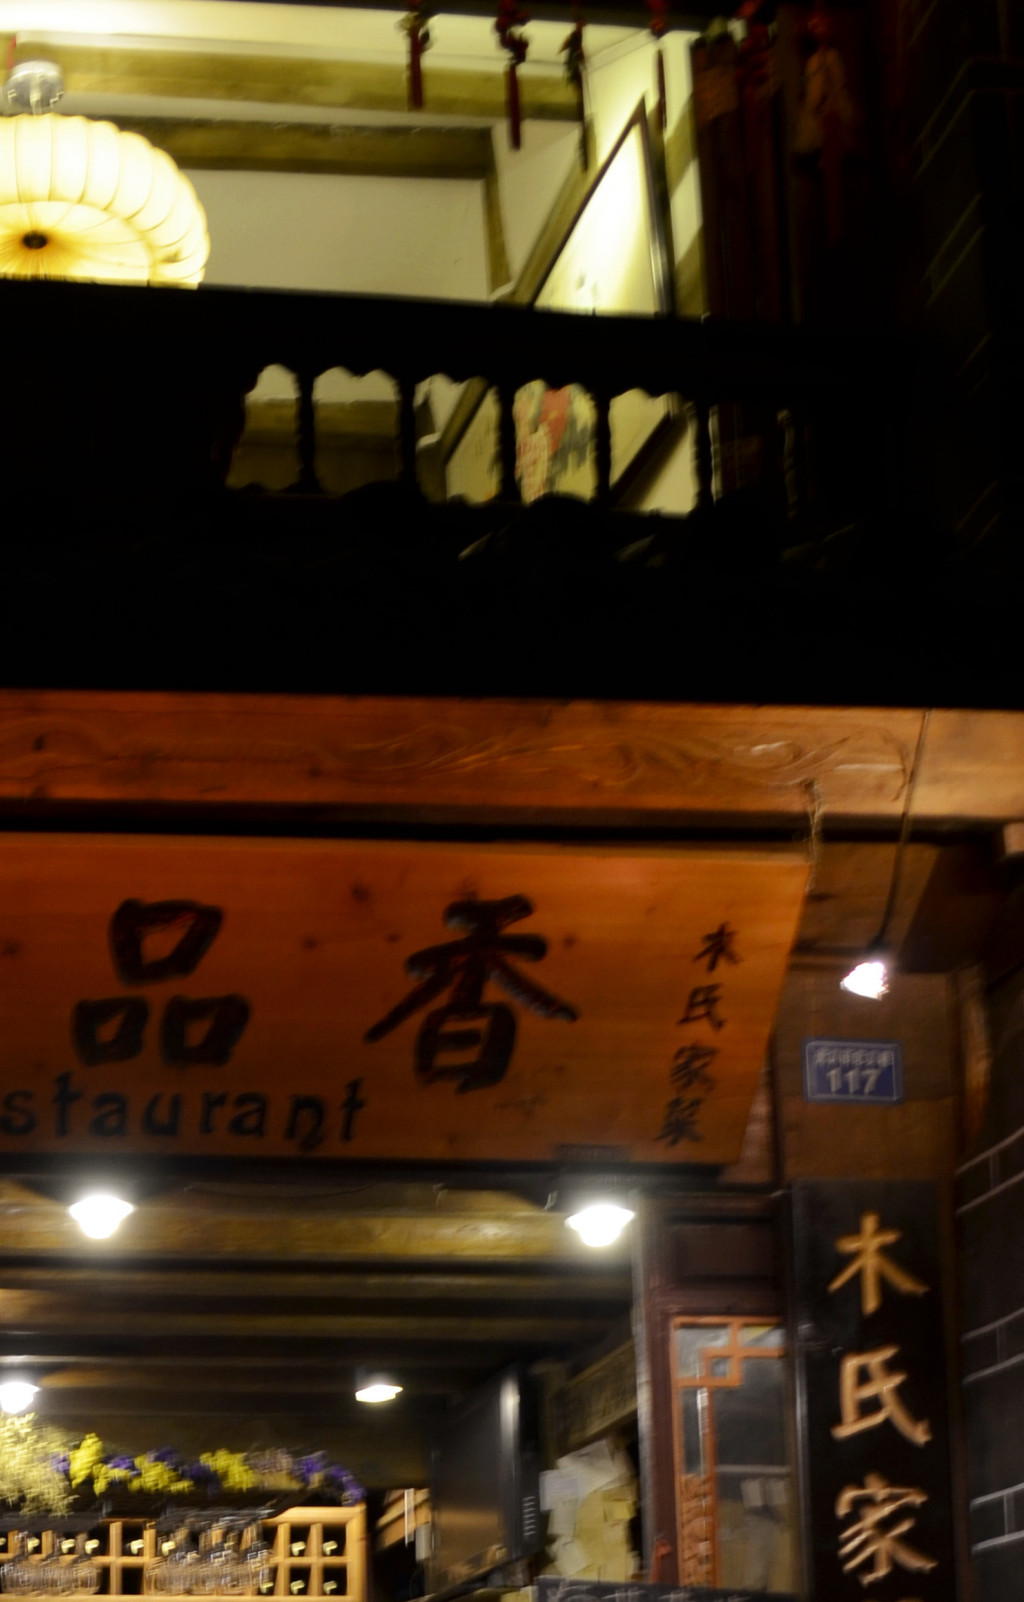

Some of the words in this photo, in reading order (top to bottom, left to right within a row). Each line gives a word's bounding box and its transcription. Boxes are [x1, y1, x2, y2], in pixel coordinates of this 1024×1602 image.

[655, 922, 743, 1145] 木氏家菜
[826, 1066, 884, 1095] 117
